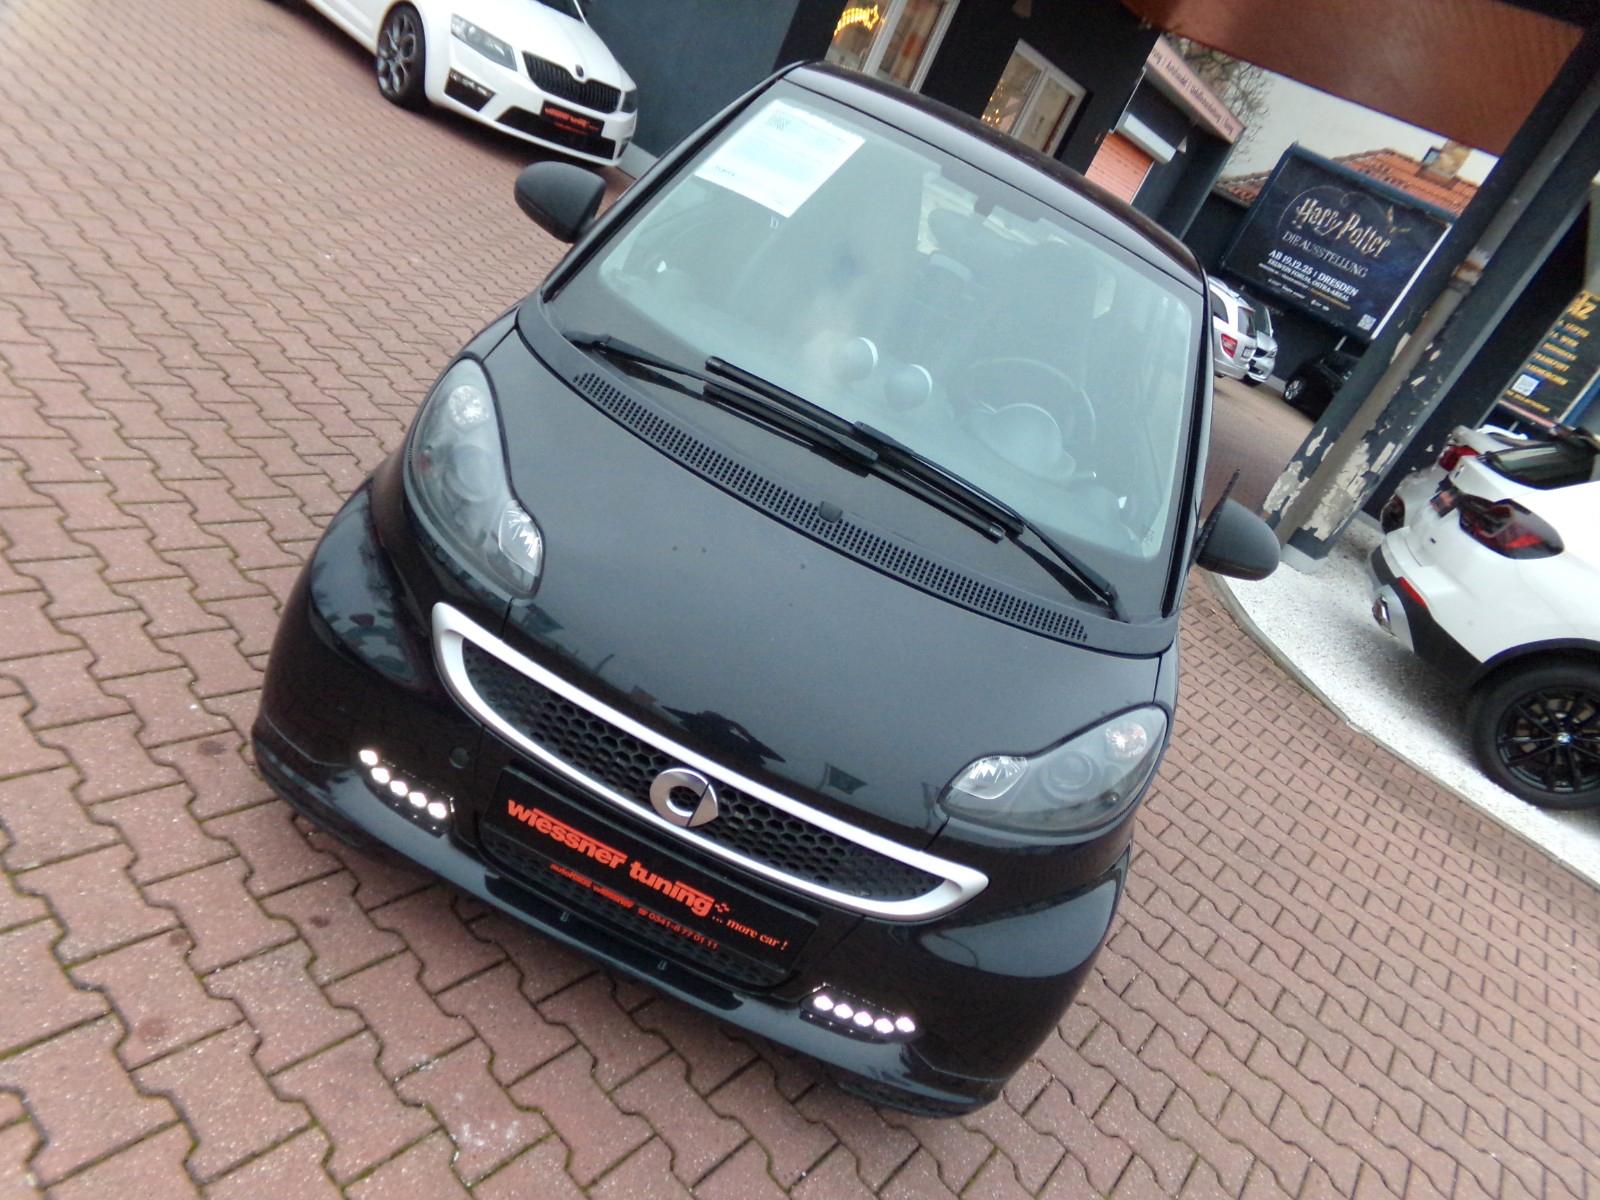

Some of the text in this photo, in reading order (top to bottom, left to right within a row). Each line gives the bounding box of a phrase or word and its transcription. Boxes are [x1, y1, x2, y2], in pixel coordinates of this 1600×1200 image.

[1296, 198, 1391, 257] Harry Potter
[1268, 249, 1283, 262] AB
[1317, 273, 1359, 297] DRESDEN
[1282, 231, 1369, 279] DIE AUSSTELLUNG
[507, 799, 629, 869] wiessner
[629, 860, 716, 917] tuning
[726, 919, 758, 939] more
[759, 934, 781, 948] car
